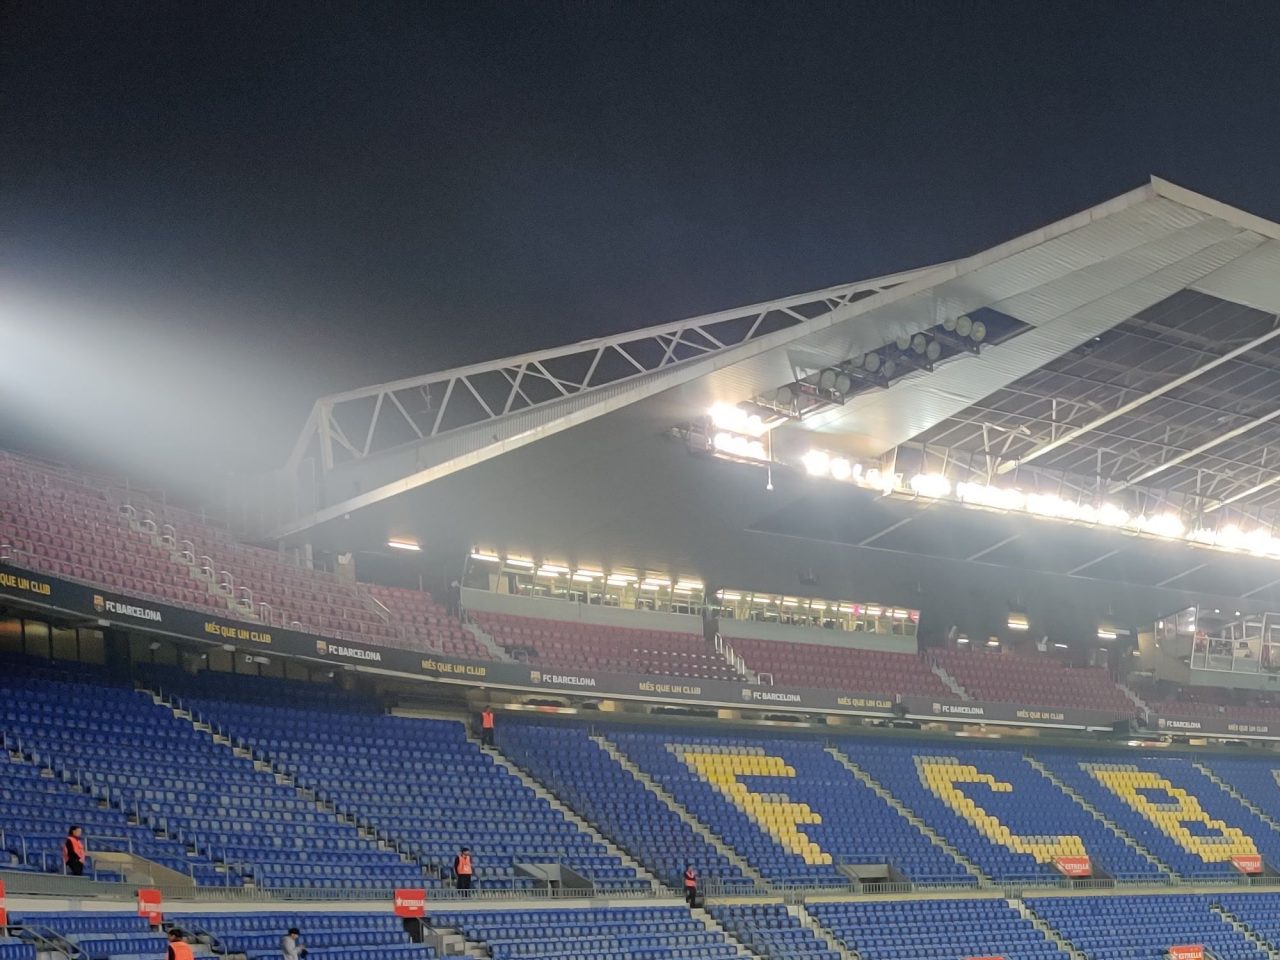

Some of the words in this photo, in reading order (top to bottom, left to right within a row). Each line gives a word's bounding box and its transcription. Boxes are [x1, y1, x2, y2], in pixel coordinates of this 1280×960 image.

[0, 573, 17, 587] QUE
[18, 577, 30, 590] UN
[31, 581, 50, 595] CLUB
[106, 601, 115, 613] FC
[116, 602, 162, 622] BARCELONA
[205, 622, 220, 636] MÉS
[221, 626, 236, 638] QUE
[238, 628, 250, 640] UN
[250, 632, 271, 644] CLUB
[329, 645, 337, 656] FC
[338, 646, 381, 661] BARCELONA
[422, 659, 436, 671] MÉS
[438, 662, 452, 674] QUE
[454, 664, 465, 674] UN
[467, 666, 486, 676] CLUB
[543, 674, 551, 684] FC
[552, 675, 595, 687] BARCELONA
[640, 682, 653, 692] MÉS
[654, 684, 669, 694] QUE
[672, 685, 682, 694] UN
[683, 686, 701, 694] CLUB
[754, 692, 761, 700] FC
[762, 692, 800, 702] BARCELONA
[838, 697, 850, 706] MÉS
[852, 698, 865, 707] QUE
[866, 699, 875, 707] UN
[876, 700, 892, 708] CLUB
[950, 706, 984, 714] BARCELONA
[1017, 710, 1028, 718] MÉS
